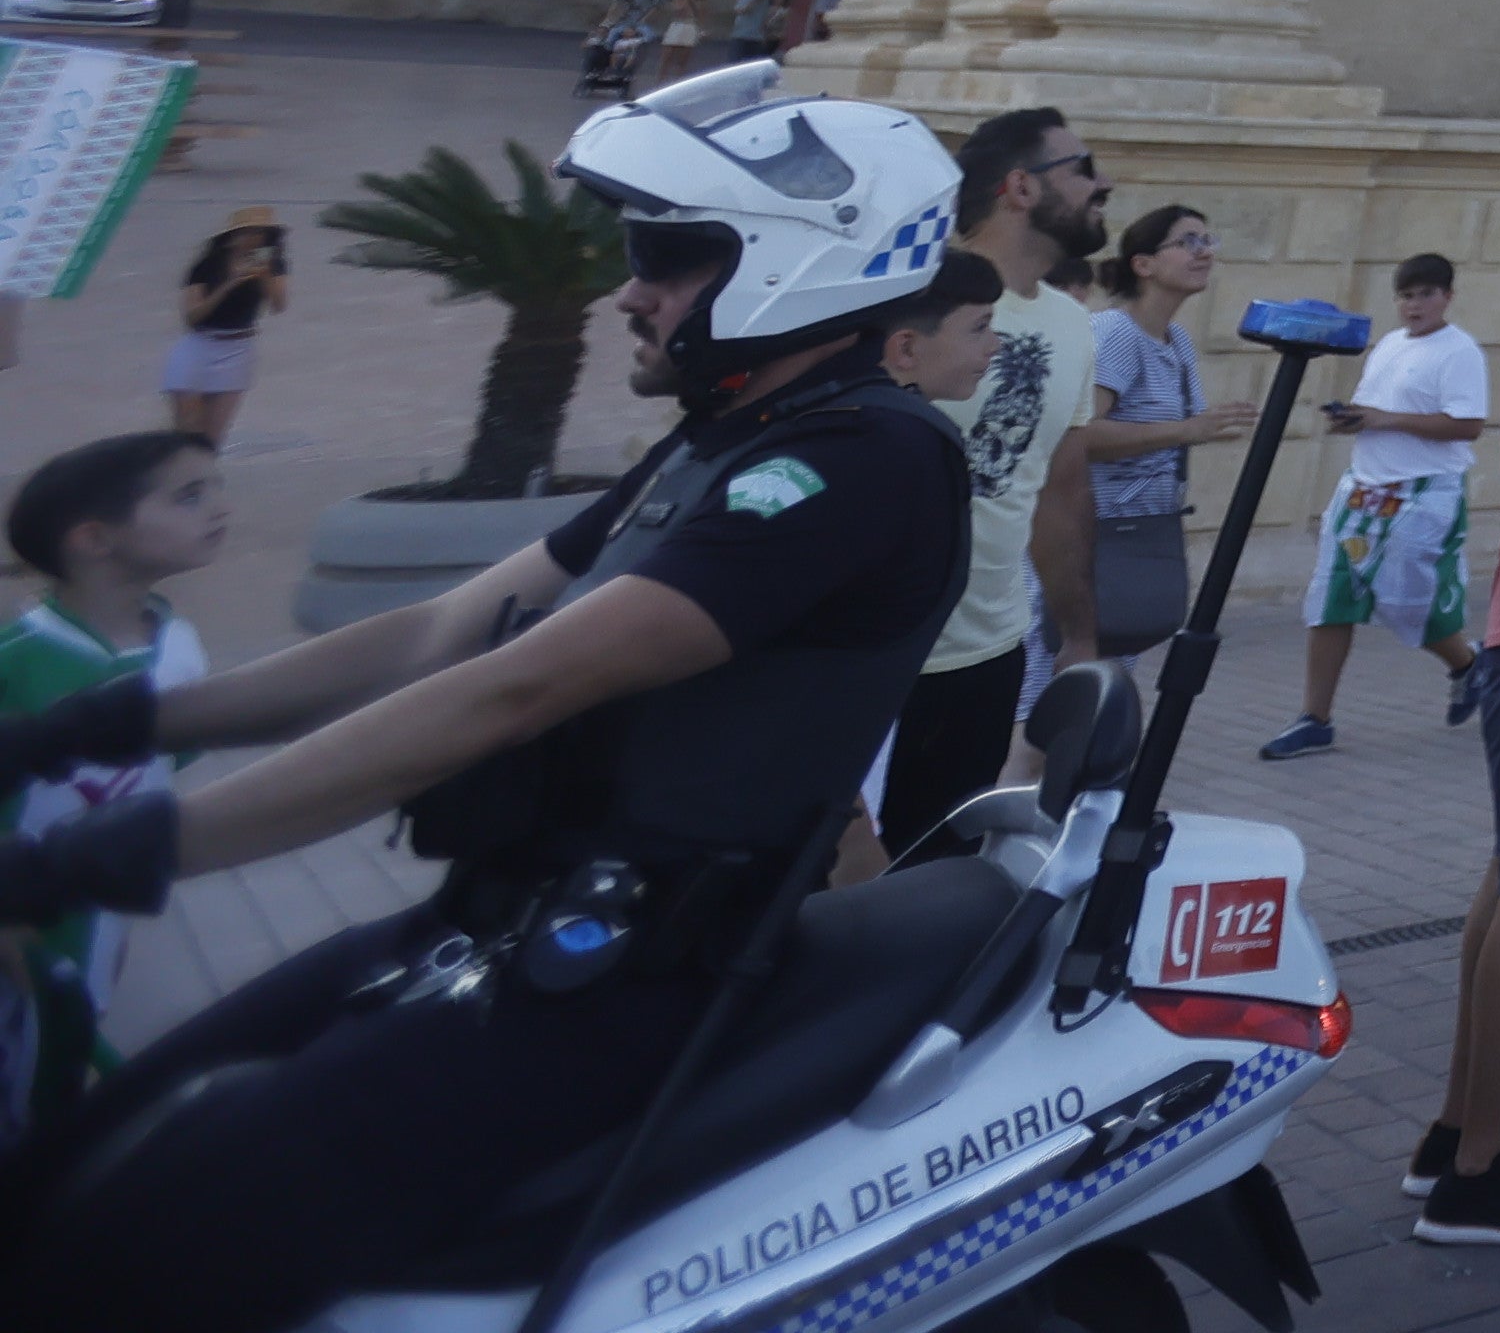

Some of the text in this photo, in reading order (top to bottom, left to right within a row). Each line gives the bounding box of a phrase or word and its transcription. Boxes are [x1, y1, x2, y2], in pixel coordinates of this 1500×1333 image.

[1214, 900, 1277, 938] 112
[643, 1084, 1086, 1314] POLICIA DE BARRIO
